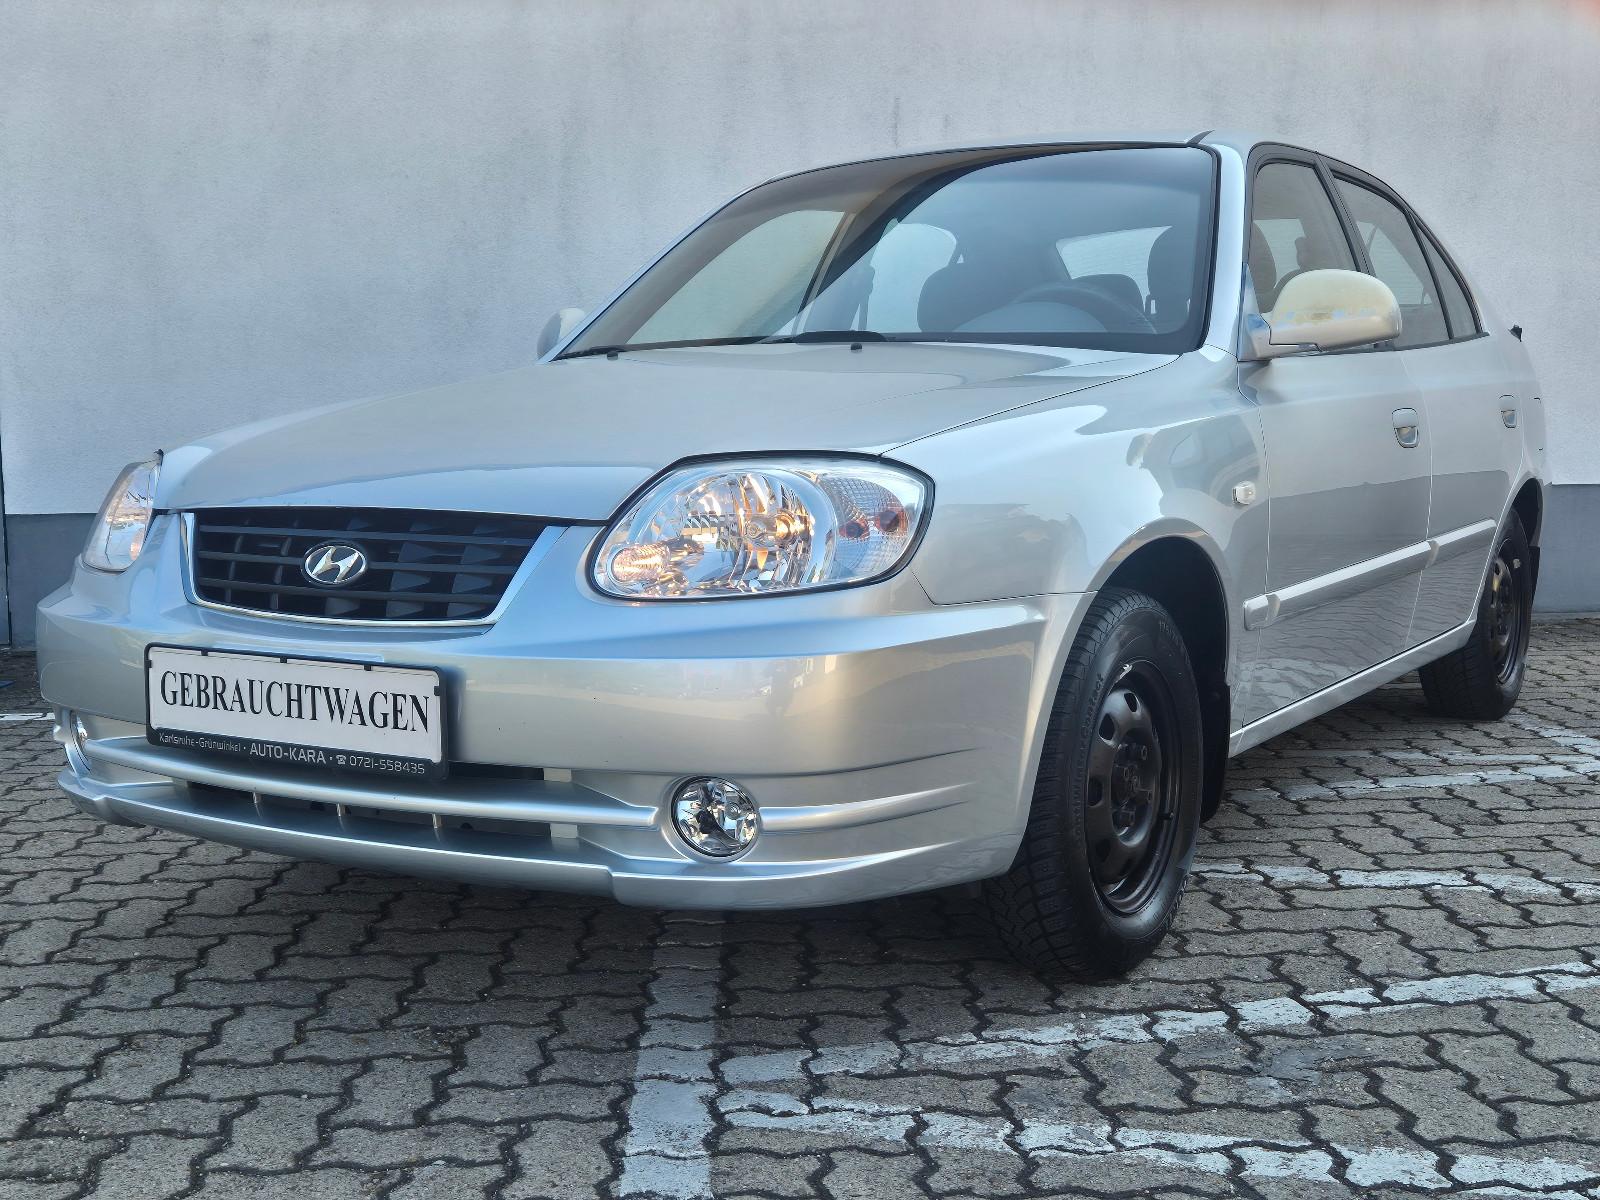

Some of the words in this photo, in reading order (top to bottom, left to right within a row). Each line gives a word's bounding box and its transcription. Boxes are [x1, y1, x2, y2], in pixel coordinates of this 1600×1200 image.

[160, 670, 430, 733] GEBRAUCHTWAGEN
[249, 742, 327, 764] AUTO-KARA
[349, 755, 425, 775] 0721-558435
